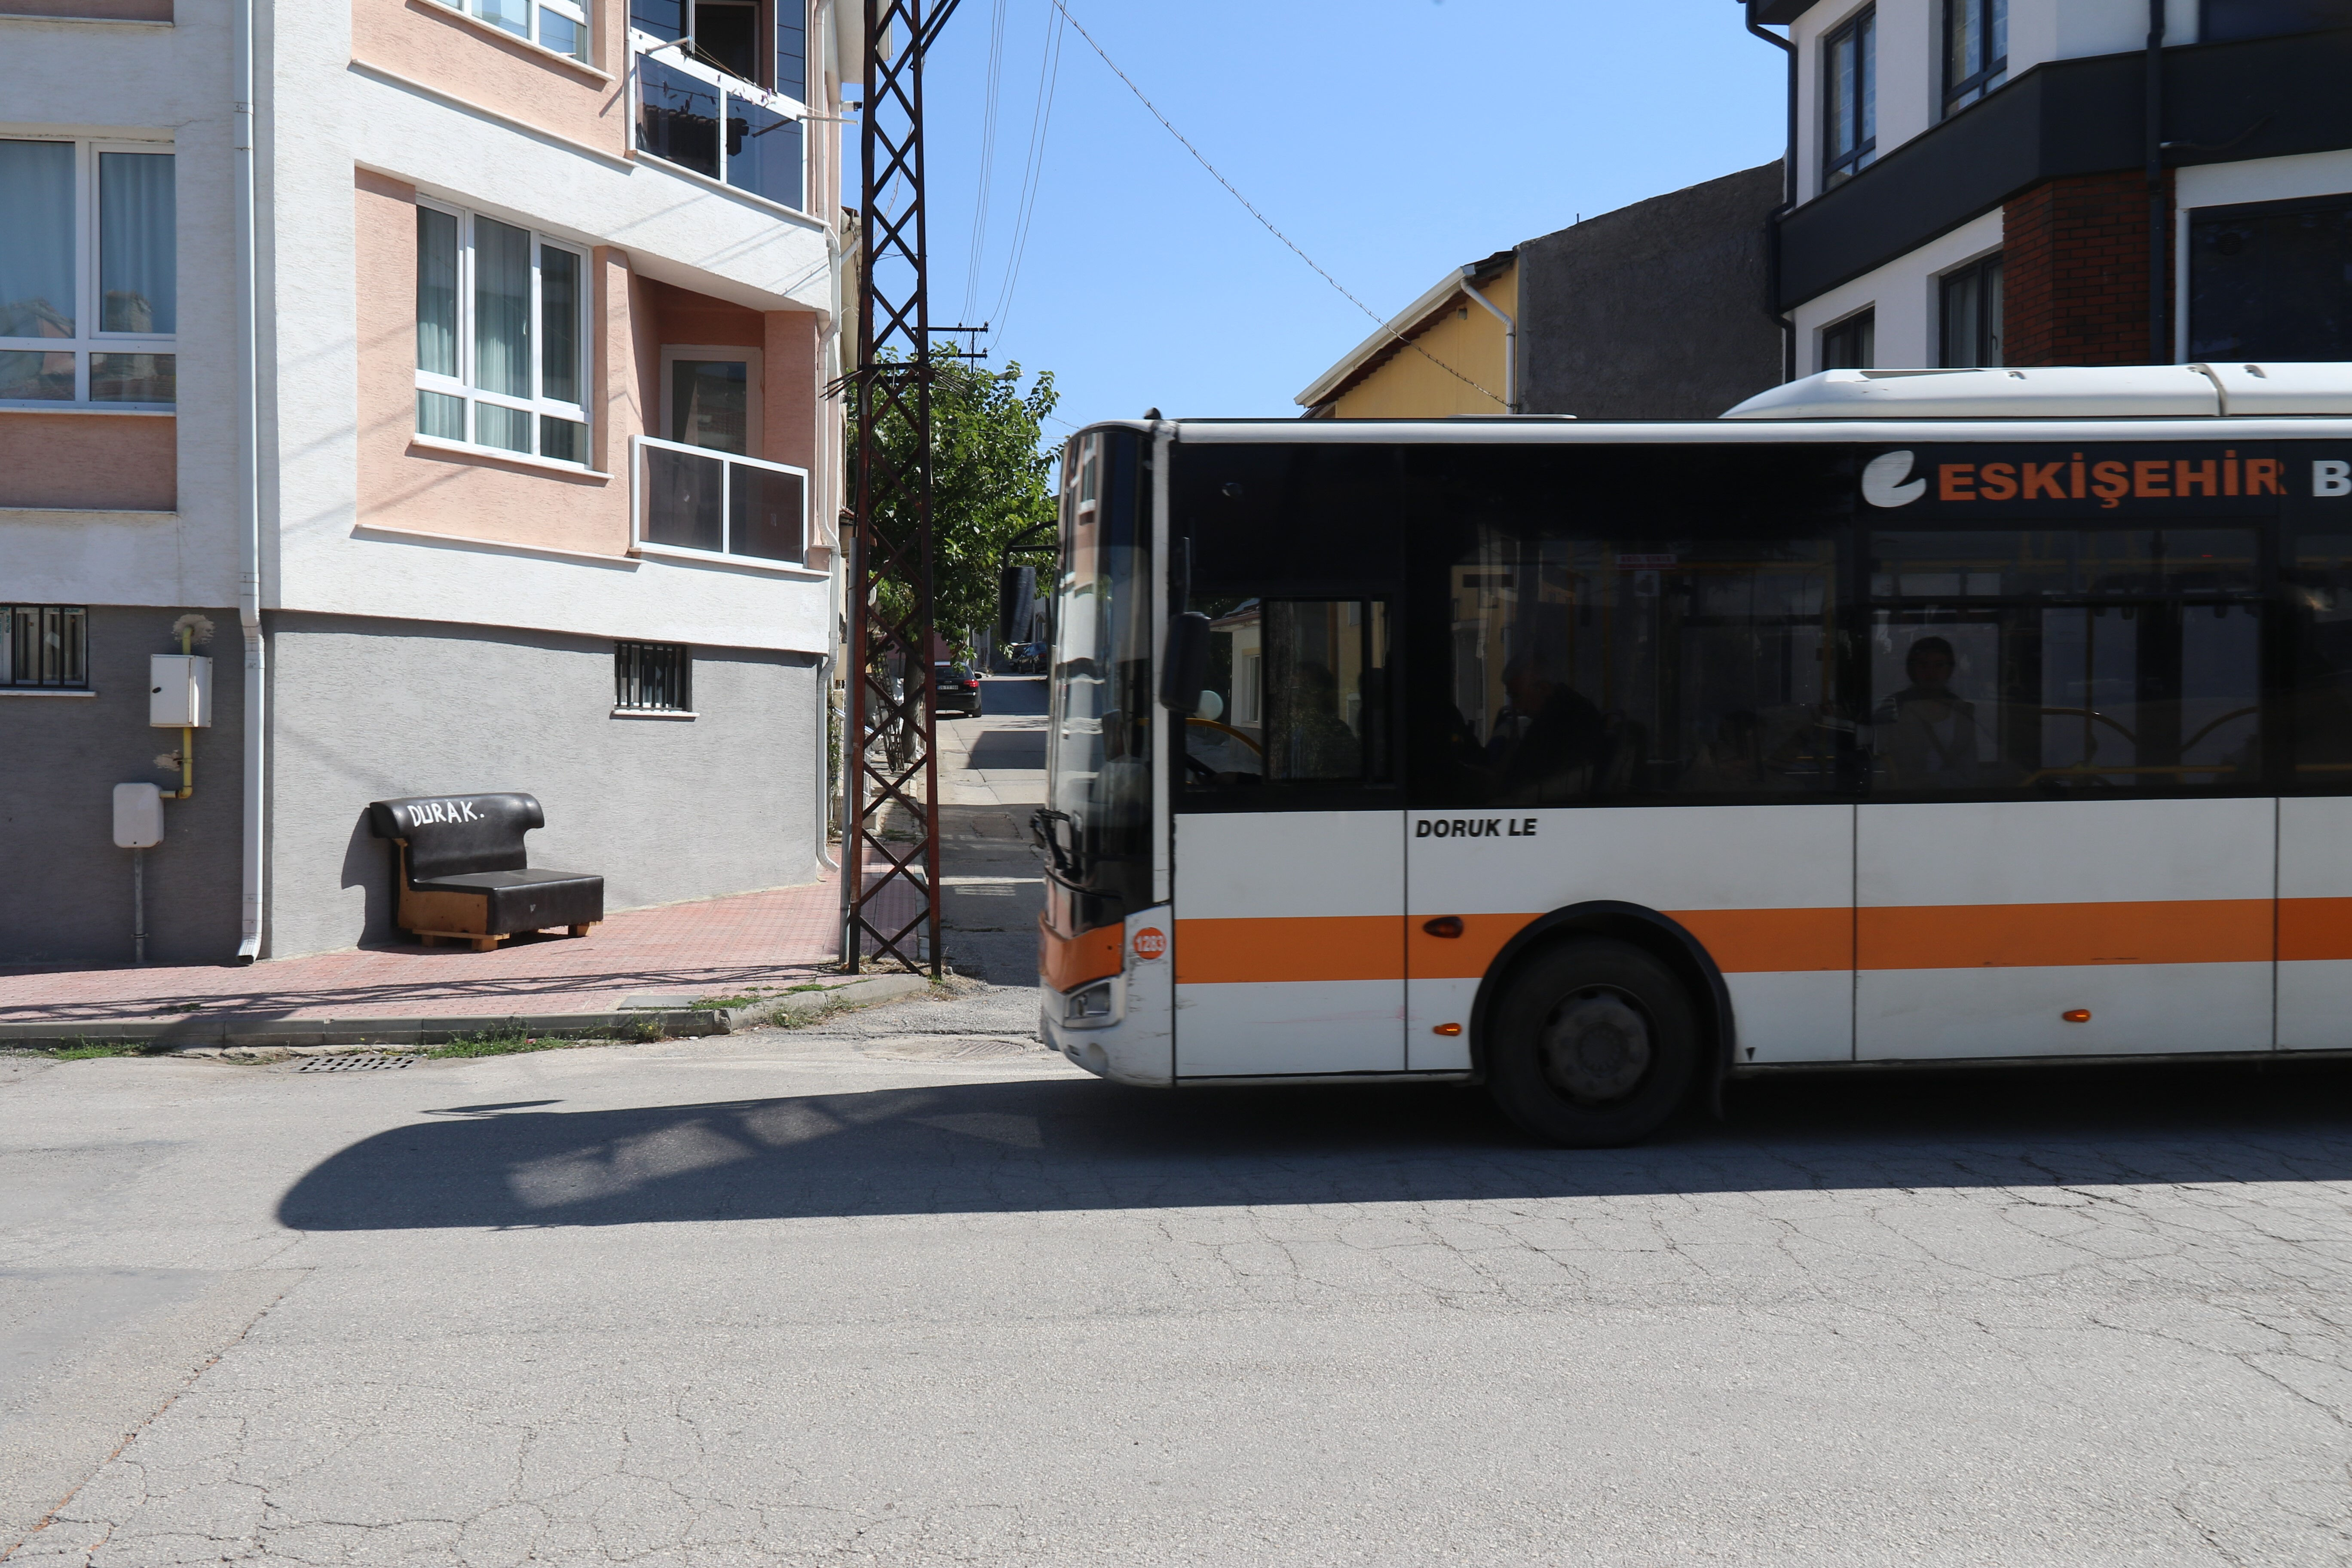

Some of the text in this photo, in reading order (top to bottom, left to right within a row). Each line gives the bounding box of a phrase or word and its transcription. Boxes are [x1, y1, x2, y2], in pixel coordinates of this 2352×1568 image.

[1939, 449, 2288, 508] ESKİŞEHİR
[1416, 818, 1538, 838] DORUK LE
[1135, 935, 1167, 952] 1283
